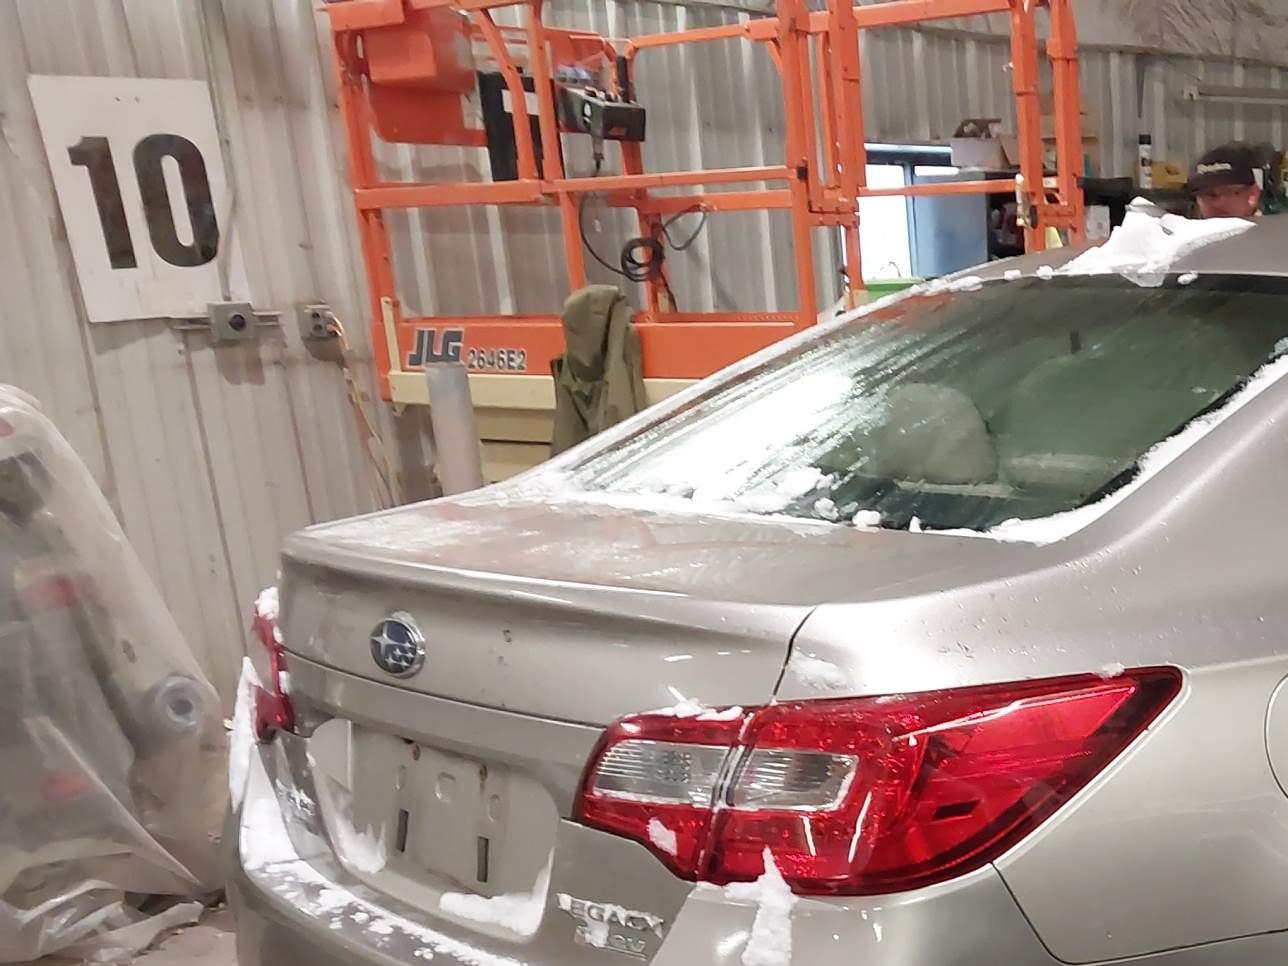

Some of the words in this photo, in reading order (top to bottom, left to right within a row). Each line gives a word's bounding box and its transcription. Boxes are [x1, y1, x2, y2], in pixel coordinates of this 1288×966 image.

[69, 134, 219, 269] 10
[407, 328, 463, 367] JLG
[467, 348, 527, 371] 2646E2
[556, 893, 664, 939] EGACY
